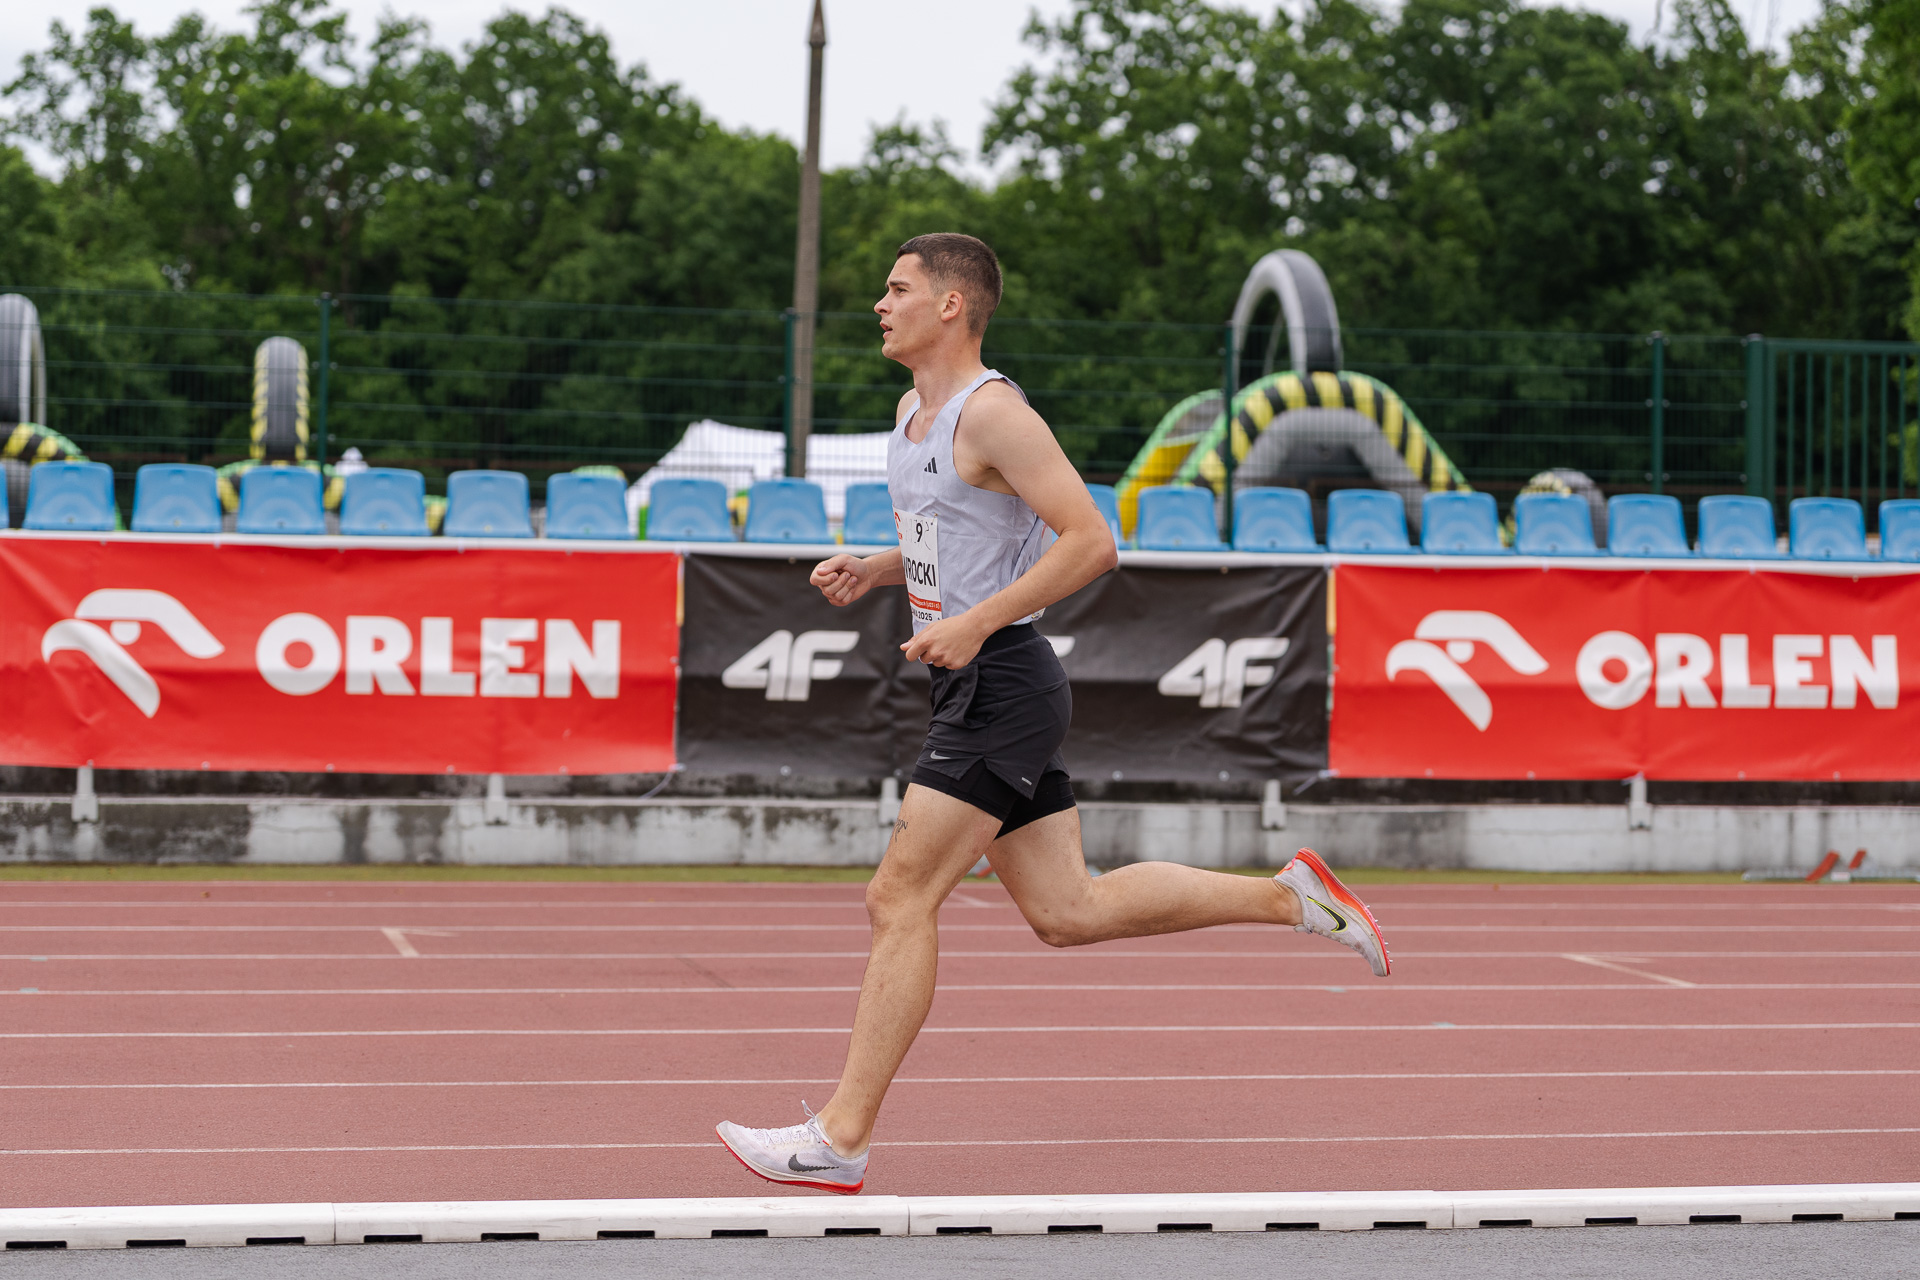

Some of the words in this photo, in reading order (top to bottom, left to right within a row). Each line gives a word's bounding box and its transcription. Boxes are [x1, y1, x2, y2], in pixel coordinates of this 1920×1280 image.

[915, 522, 923, 543] 9
[256, 613, 620, 697] ORLEN
[724, 631, 858, 699] 4F
[1160, 638, 1288, 706] 4F
[1576, 632, 1898, 708] ORLEN
